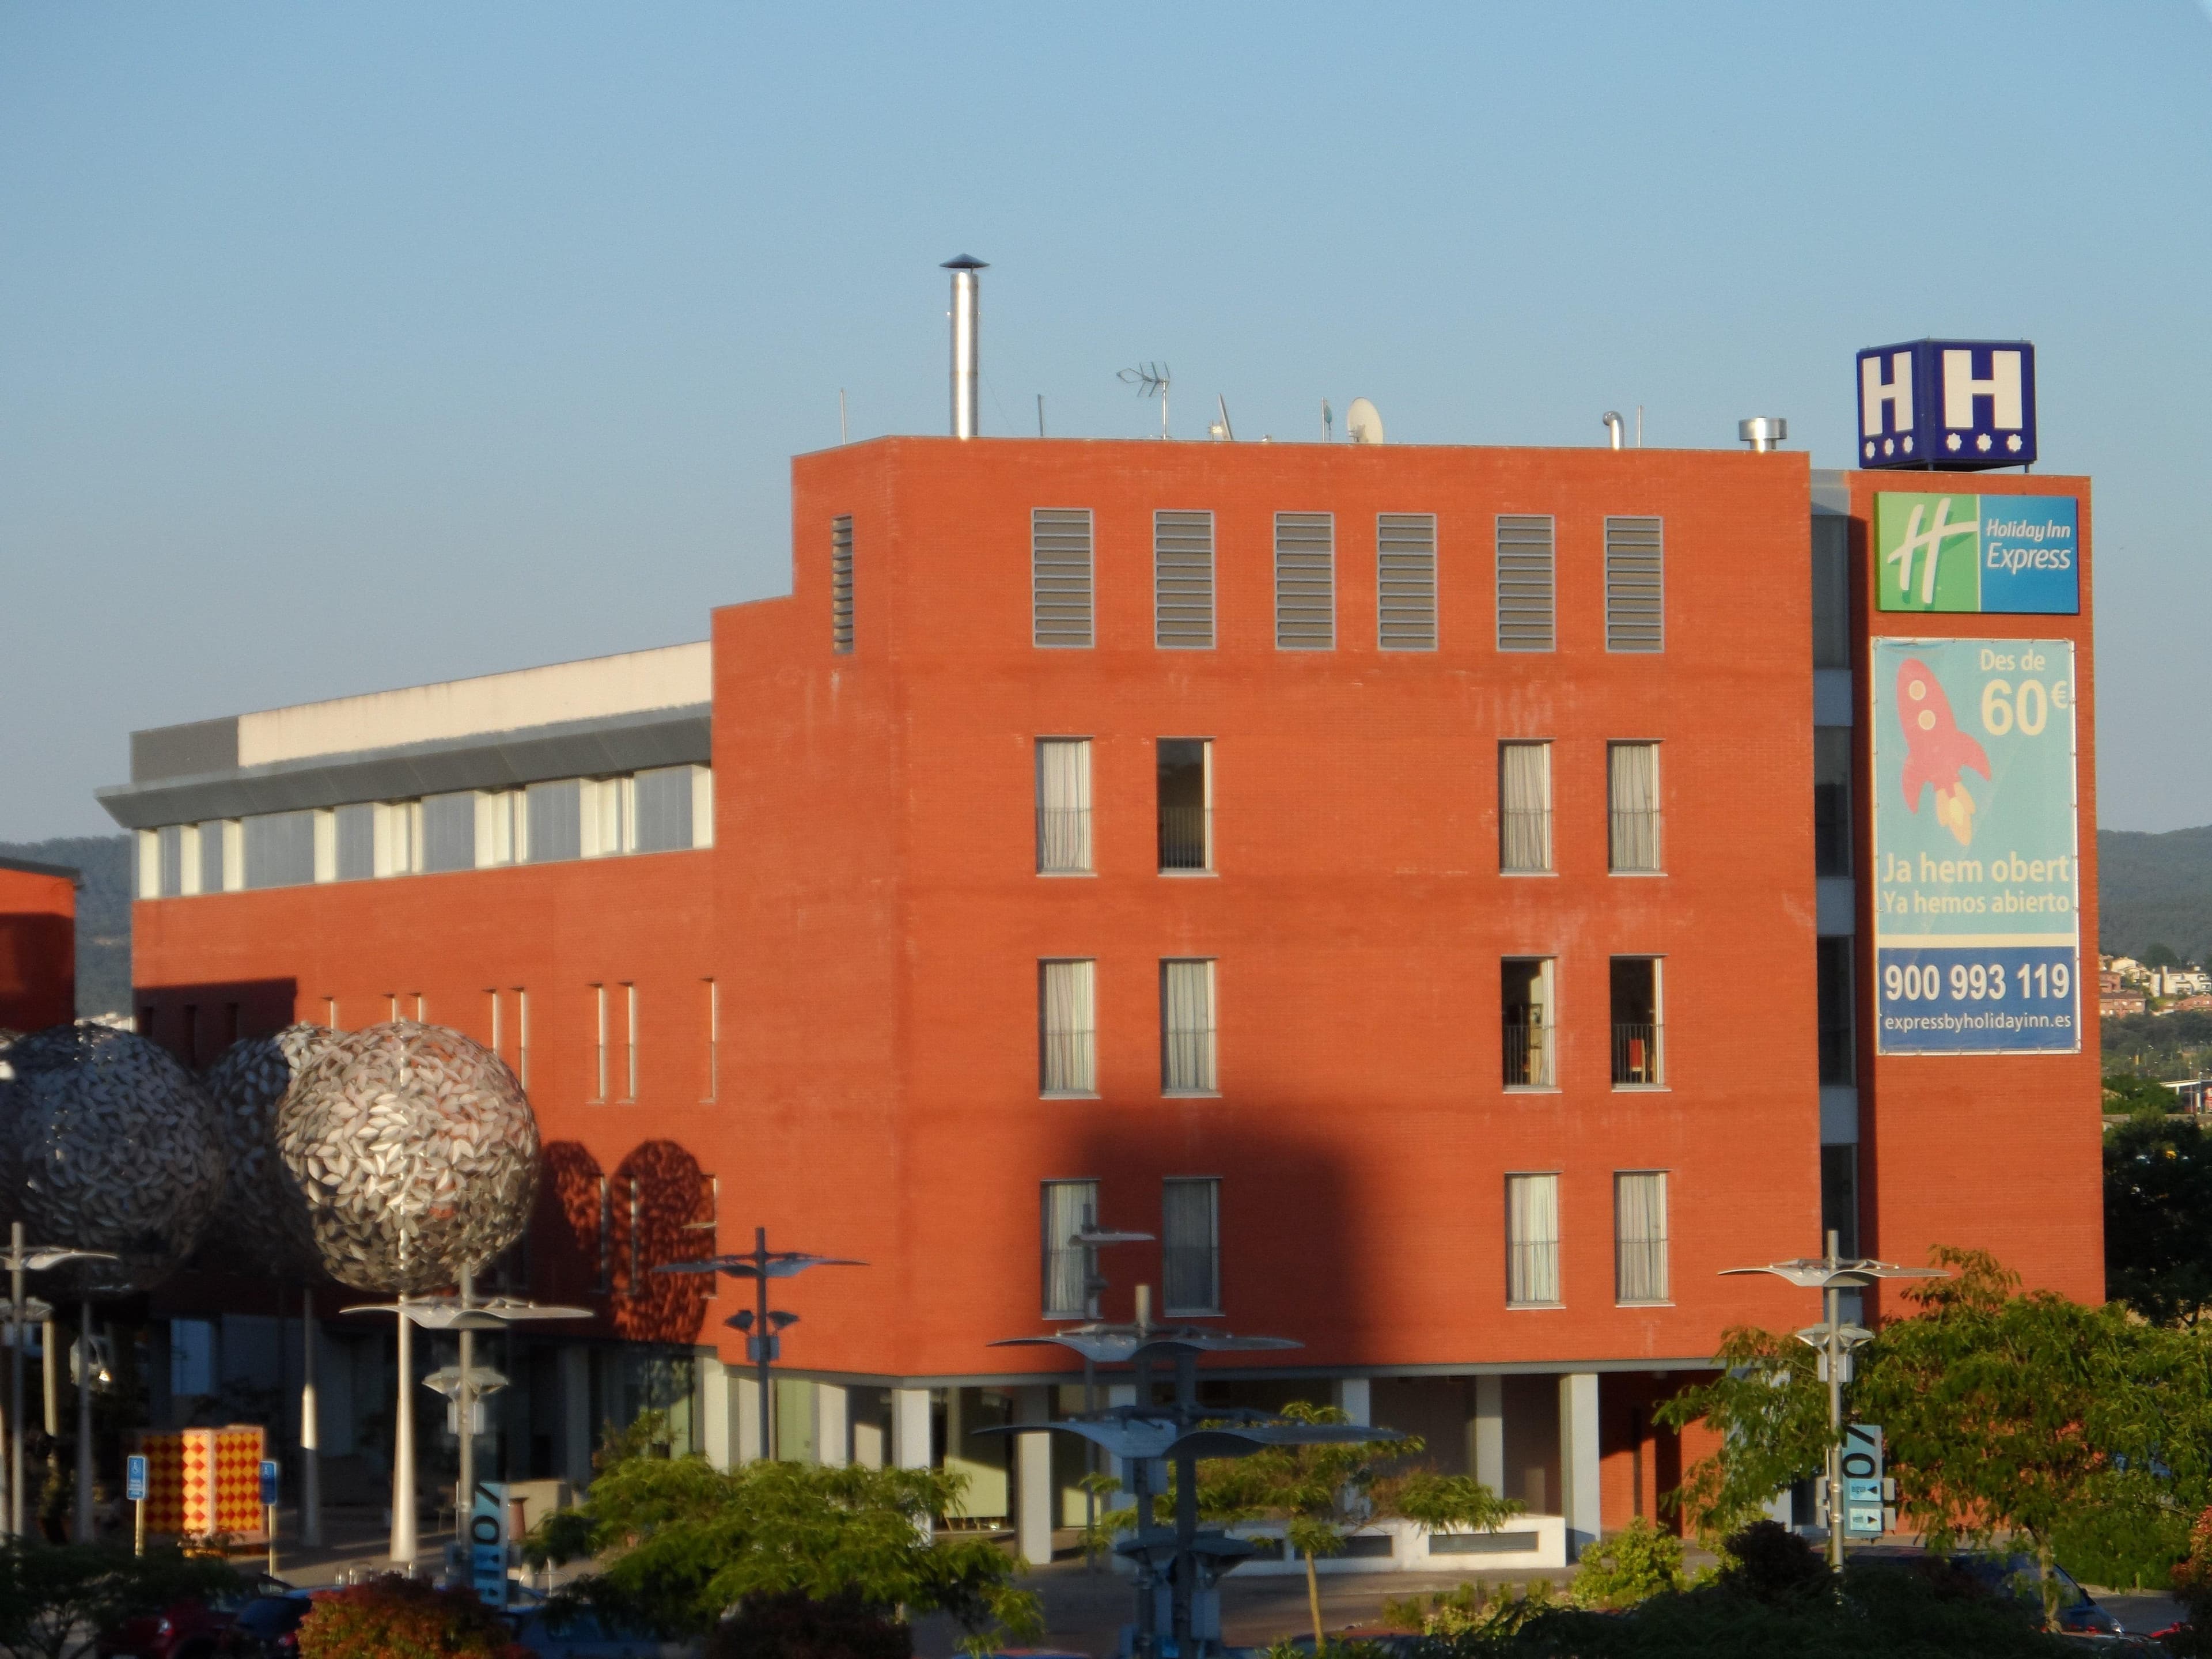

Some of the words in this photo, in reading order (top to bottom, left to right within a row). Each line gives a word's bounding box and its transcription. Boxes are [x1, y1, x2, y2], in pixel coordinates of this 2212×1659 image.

[1862, 351, 1913, 437] H
[1944, 349, 2023, 429] H
[1986, 518, 2046, 542] Holiday
[2047, 520, 2071, 538] Inn
[1987, 543, 2071, 575] Express
[1980, 649, 2016, 671] Des
[2021, 649, 2046, 671] de
[1883, 854, 1911, 883] Ja
[1921, 852, 1983, 882] hem
[1991, 851, 2069, 882] obert
[1883, 891, 1908, 914] Ya
[1914, 891, 1986, 913] hemos
[1991, 890, 2069, 912] abierto
[1884, 965, 1940, 1001] 900
[1950, 964, 2006, 1000] 993
[2017, 963, 2070, 999] 119
[1884, 1012, 2071, 1033] expressbyholidayinn.es
